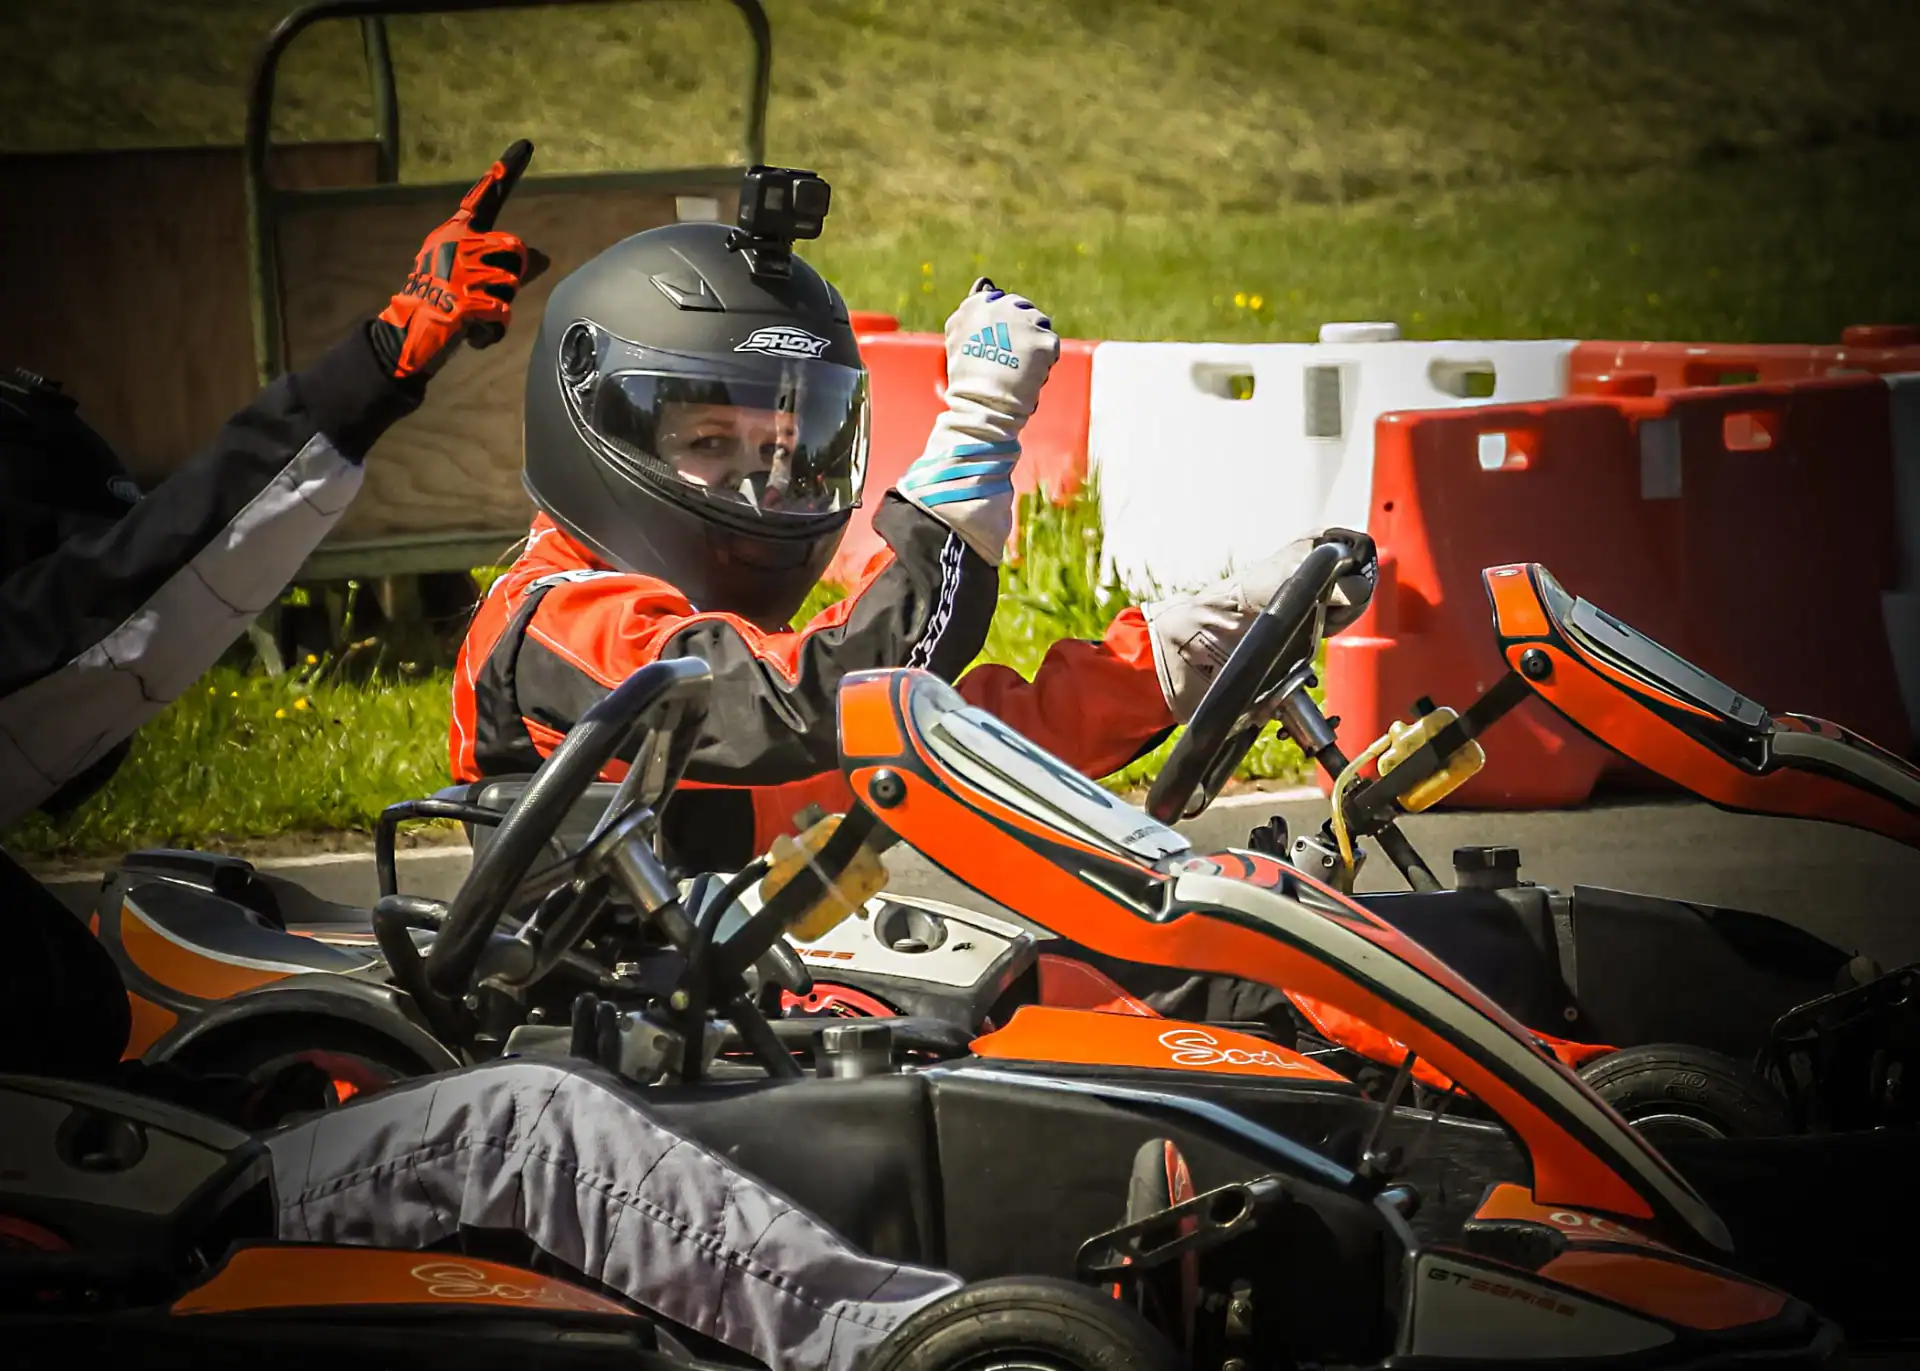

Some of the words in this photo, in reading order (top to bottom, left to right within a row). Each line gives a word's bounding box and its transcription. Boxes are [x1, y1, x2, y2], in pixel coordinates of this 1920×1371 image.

[402, 273, 457, 314] didas
[746, 333, 823, 354] SHOX
[961, 342, 1020, 369] adidas
